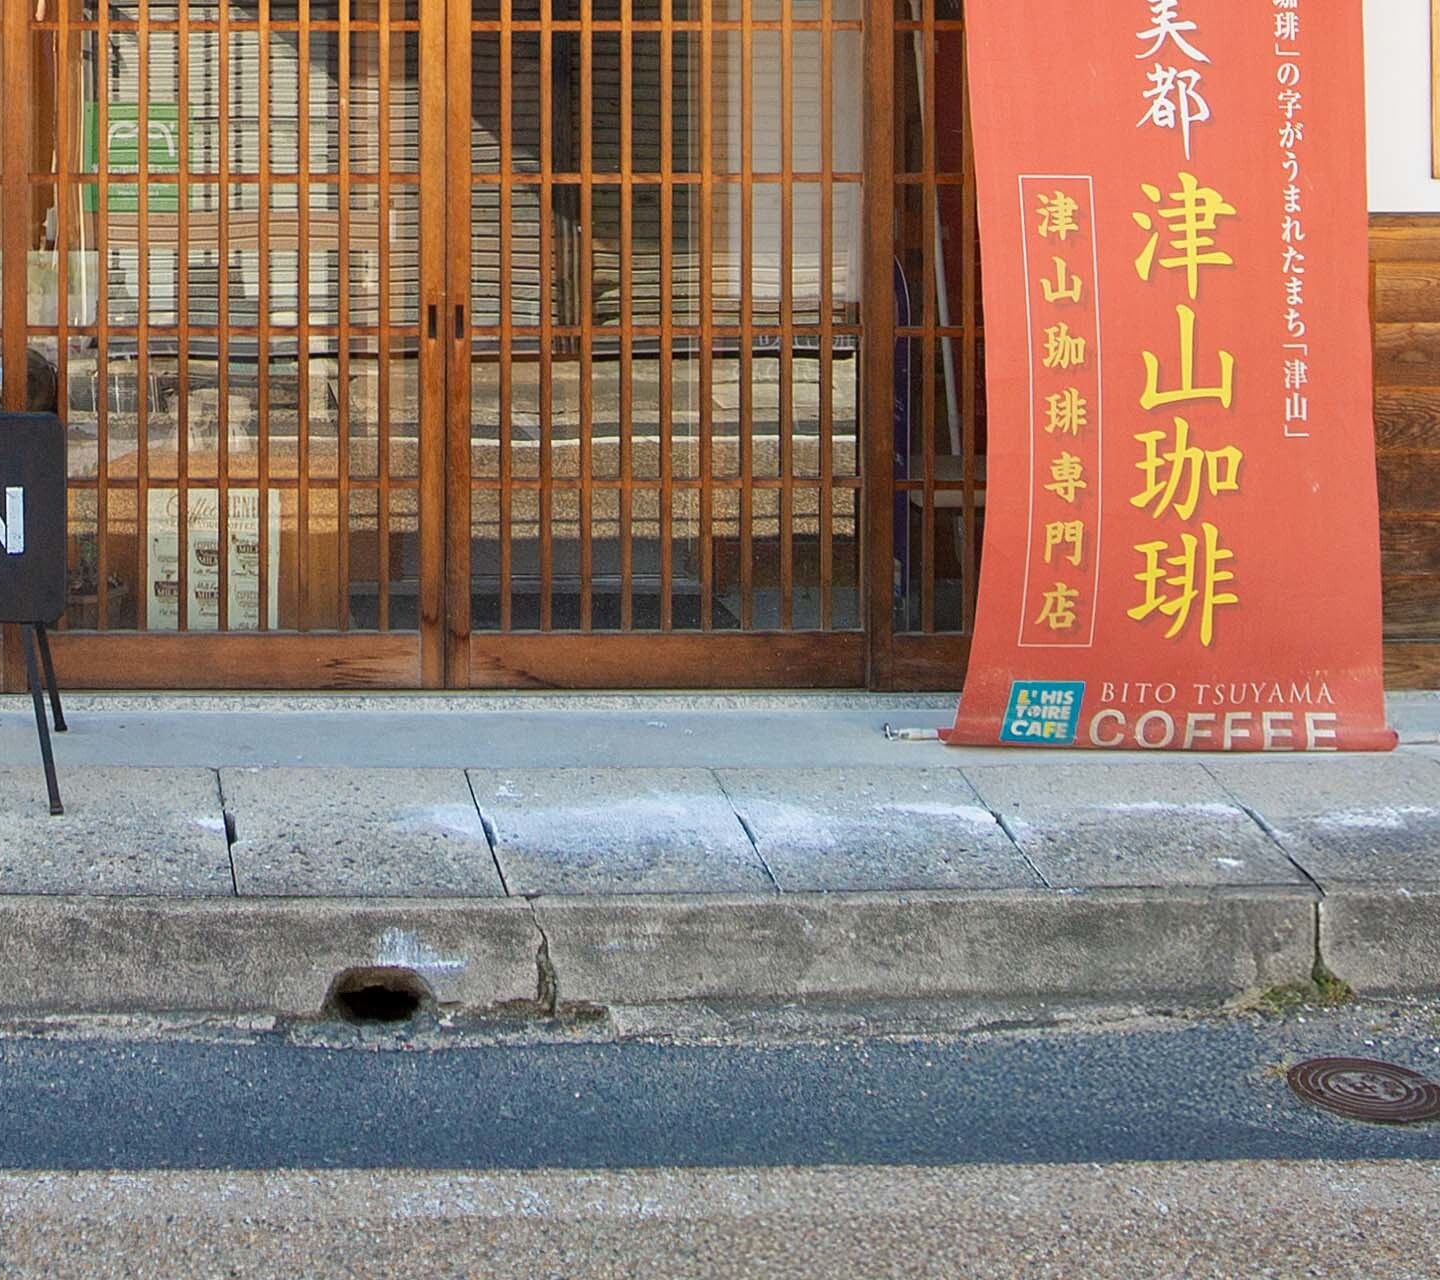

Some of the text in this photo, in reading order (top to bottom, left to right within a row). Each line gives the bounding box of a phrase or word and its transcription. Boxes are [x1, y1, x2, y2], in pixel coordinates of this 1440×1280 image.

[1035, 189, 1088, 630] 津山珈琲専門店
[1127, 171, 1244, 647] 津山珈琲
[1099, 682, 1336, 705] BITO TSUYAMA
[1010, 719, 1069, 738] CAFE
[1088, 709, 1337, 751] COFFEE
